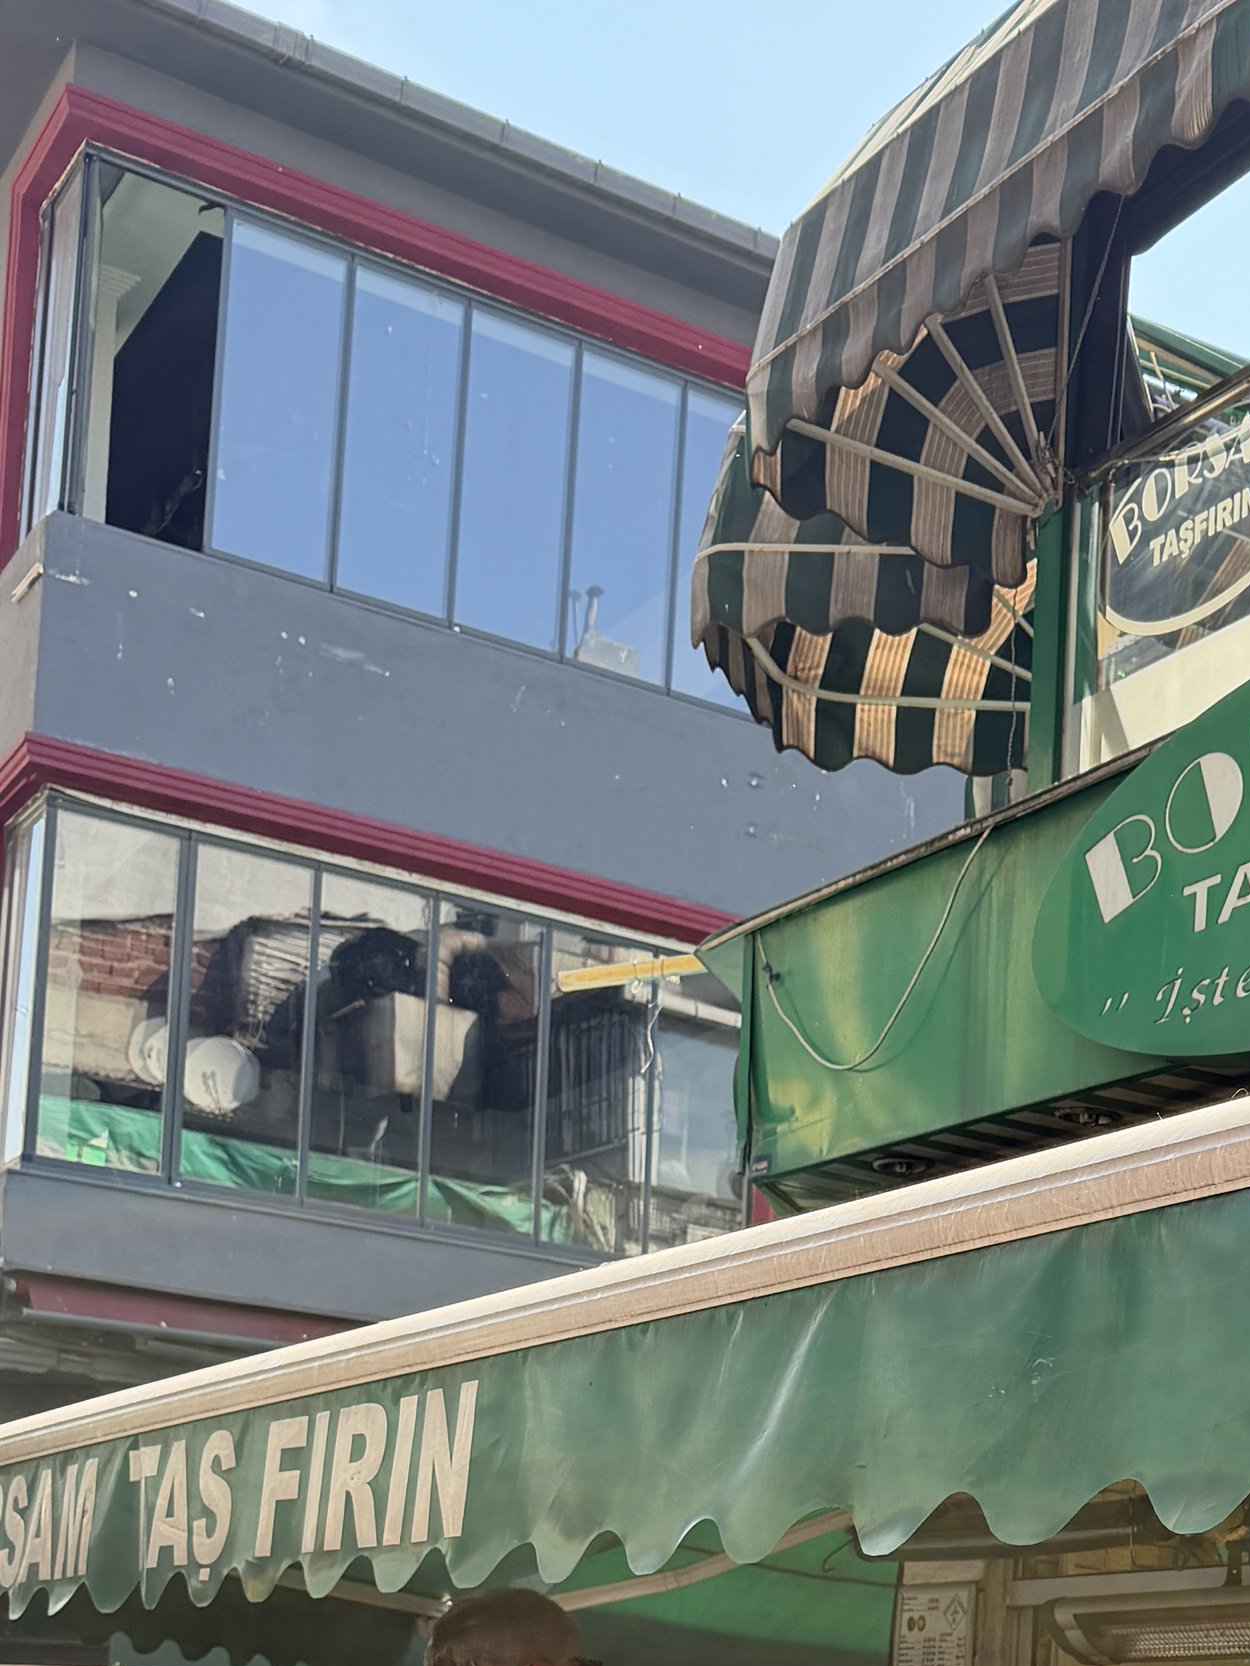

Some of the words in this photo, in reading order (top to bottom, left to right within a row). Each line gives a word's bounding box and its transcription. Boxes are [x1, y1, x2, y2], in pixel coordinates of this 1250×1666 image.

[0, 1458, 99, 1588] SAM
[129, 1430, 237, 1581] TAŞ
[254, 1380, 479, 1558] FIRIN
